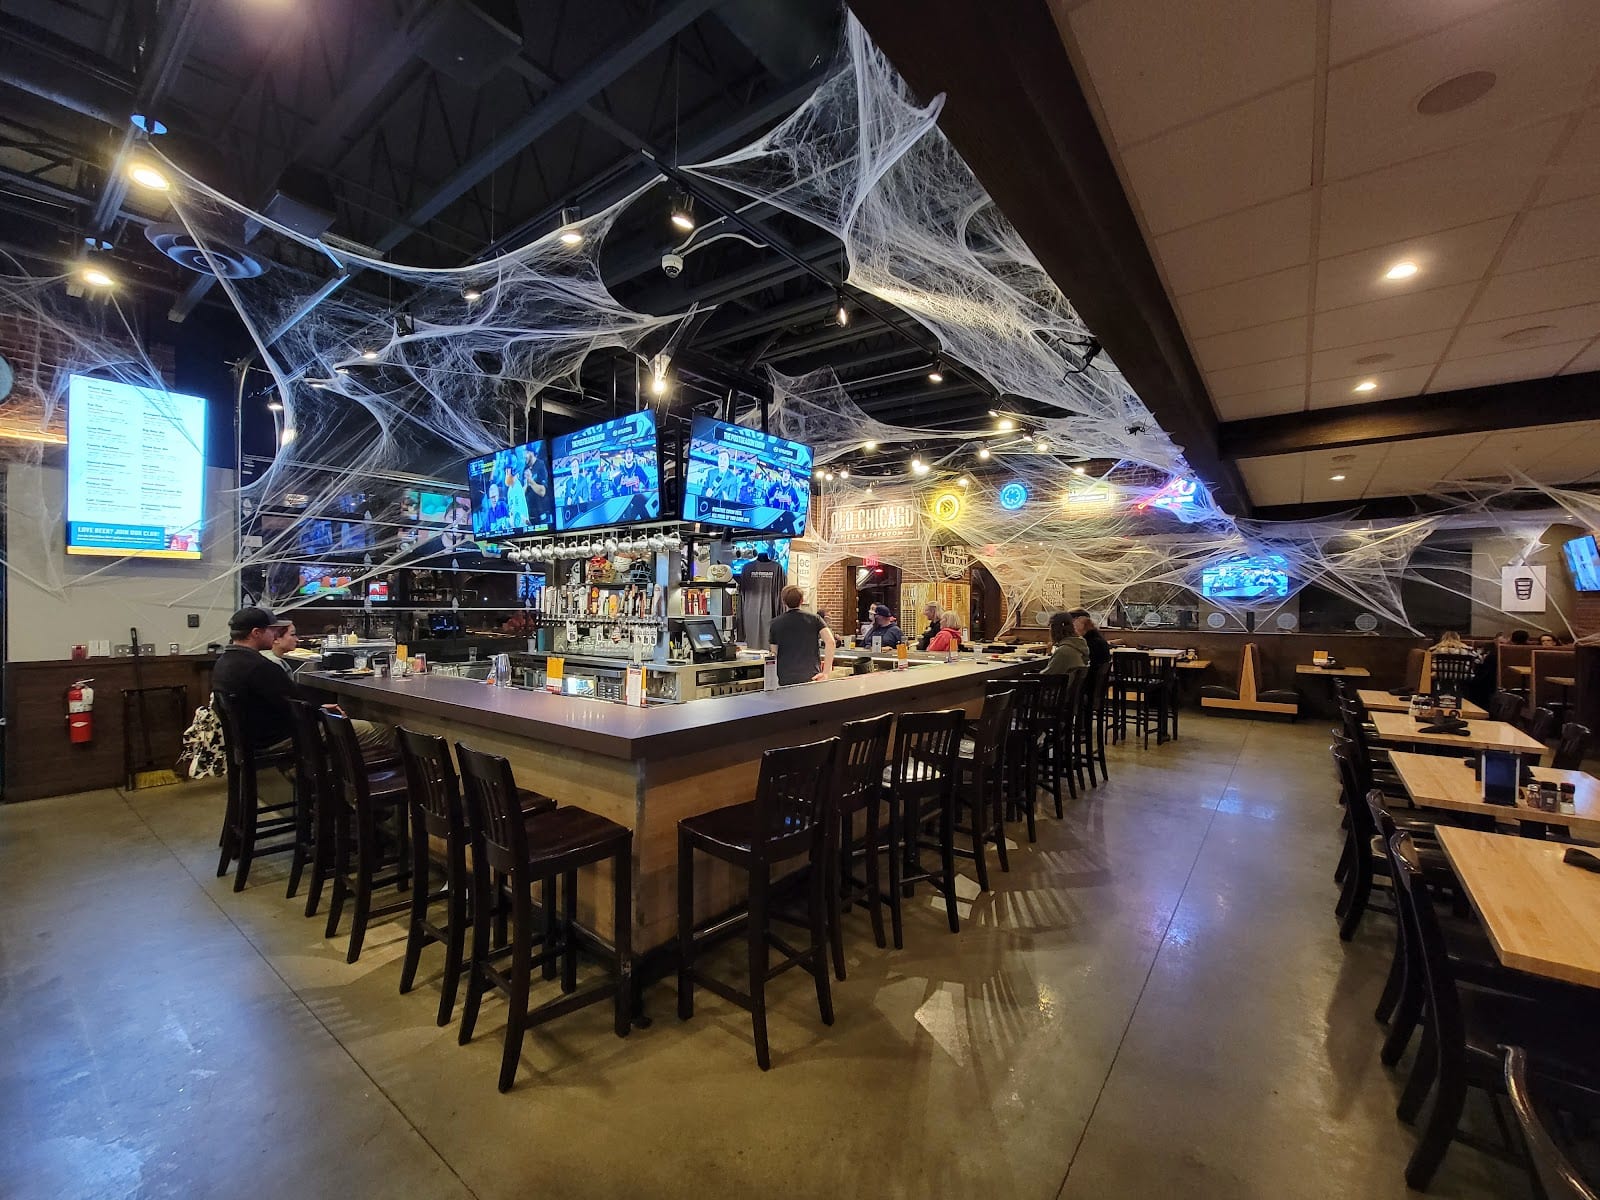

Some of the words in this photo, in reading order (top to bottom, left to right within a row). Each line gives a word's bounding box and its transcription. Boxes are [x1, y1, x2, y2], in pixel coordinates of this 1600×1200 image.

[831, 511, 854, 532] OLD
[858, 503, 914, 530] CHICAGO
[870, 530, 904, 538] TAPROOM
